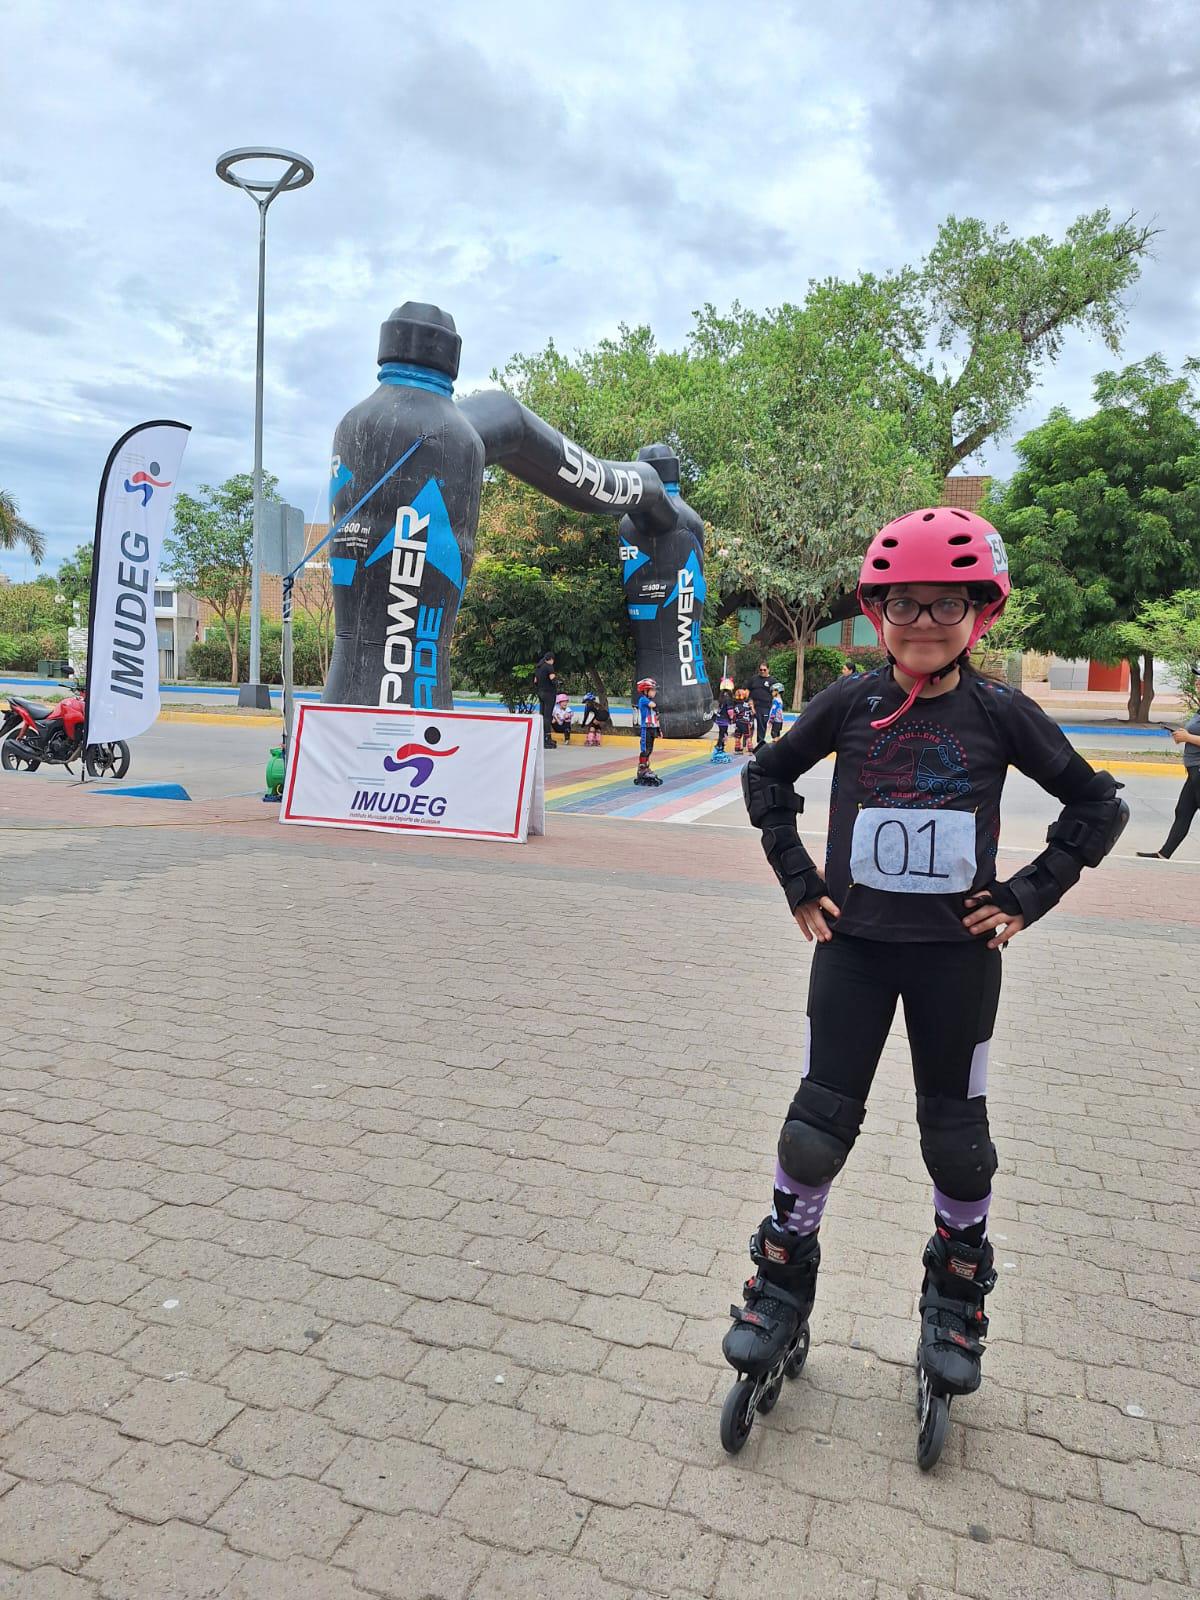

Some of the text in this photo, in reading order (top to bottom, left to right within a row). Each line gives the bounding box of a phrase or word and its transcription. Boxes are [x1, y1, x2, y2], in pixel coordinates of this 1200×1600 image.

[557, 438, 643, 505] SALIDA
[344, 522, 361, 534] 600
[110, 530, 150, 700] IMUDEG
[379, 505, 430, 708] POWER
[677, 568, 698, 686] POWER
[413, 605, 443, 708] ADE
[351, 790, 447, 817] IMUDEG
[874, 819, 949, 879] 01
